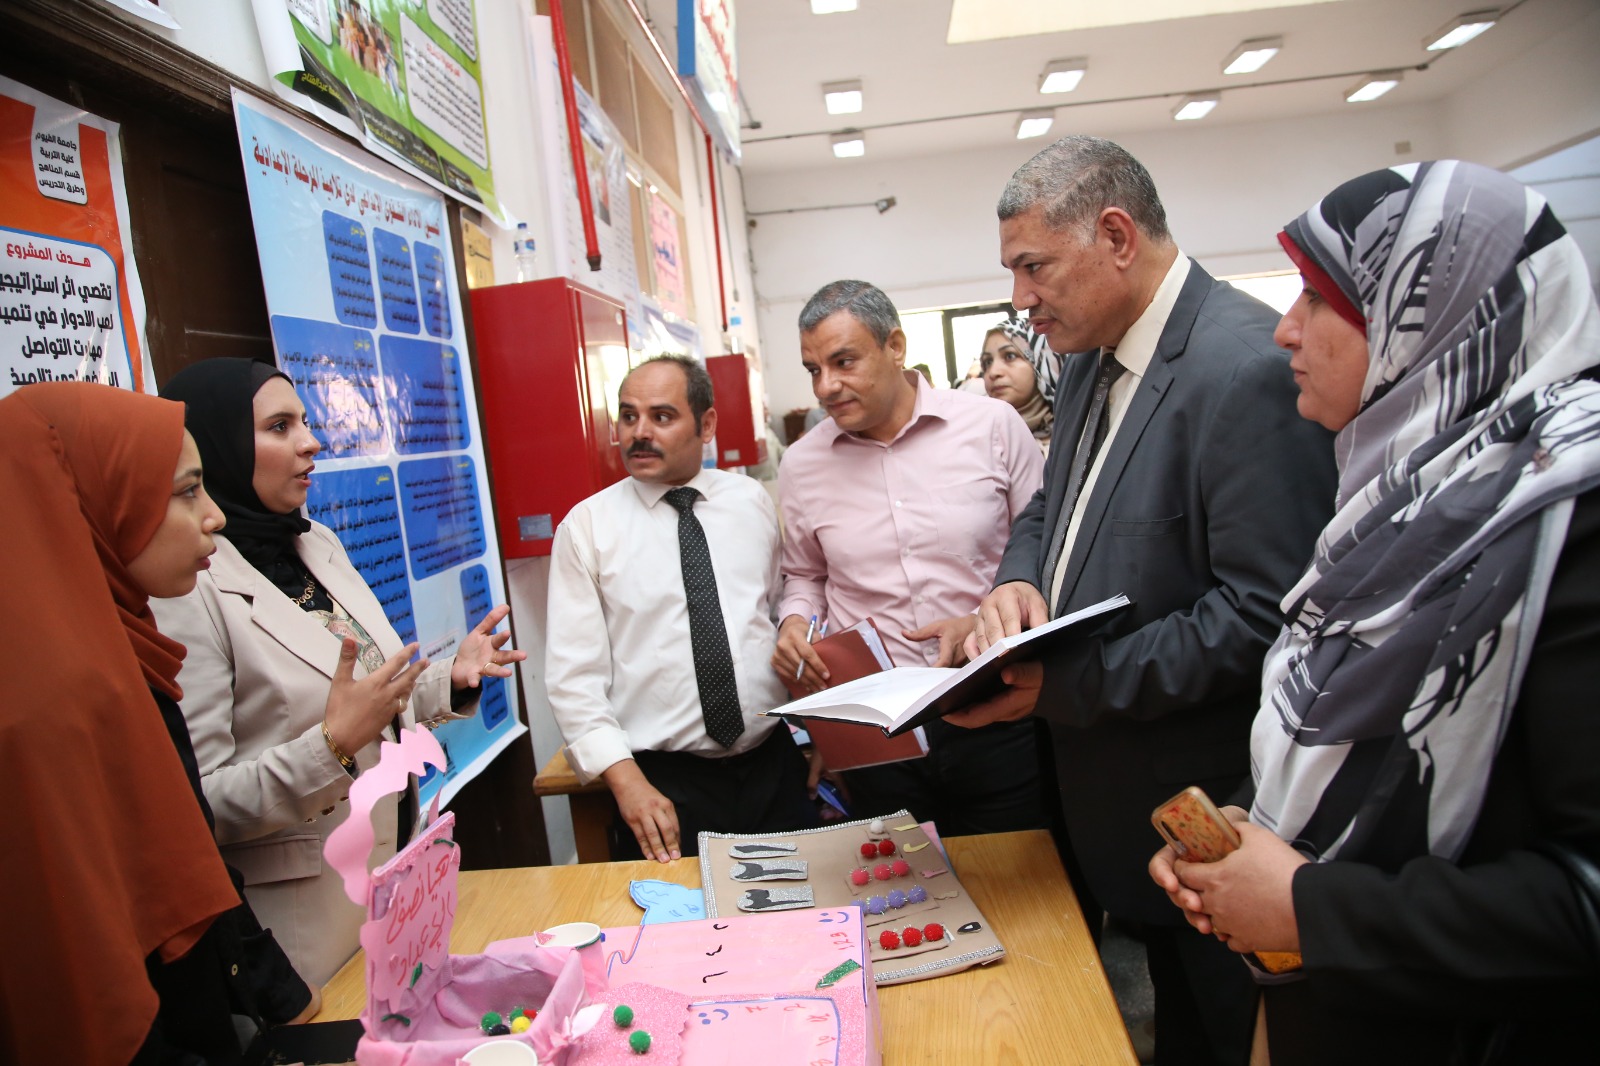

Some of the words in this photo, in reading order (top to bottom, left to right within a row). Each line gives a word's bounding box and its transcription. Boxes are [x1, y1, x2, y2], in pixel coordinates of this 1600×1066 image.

[36, 132, 56, 144] الفيوم
[57, 136, 77, 151] جامعة
[40, 146, 60, 160] التربية
[61, 152, 74, 164] كلية
[252, 135, 292, 185] الإعدادية
[38, 163, 63, 174] المناهج
[292, 153, 320, 193] المرحلة
[38, 179, 66, 189] التدريس
[320, 166, 343, 202] تلاميذ
[6, 242, 52, 260] المشروع
[0, 272, 59, 296] استراتيجي
[62, 275, 76, 300] اثر
[78, 282, 112, 303] تقصي
[0, 304, 32, 325] تنمي
[34, 306, 58, 330] في
[60, 308, 96, 330] الادوار
[96, 314, 114, 332] لعب
[22, 336, 72, 360] التواصل
